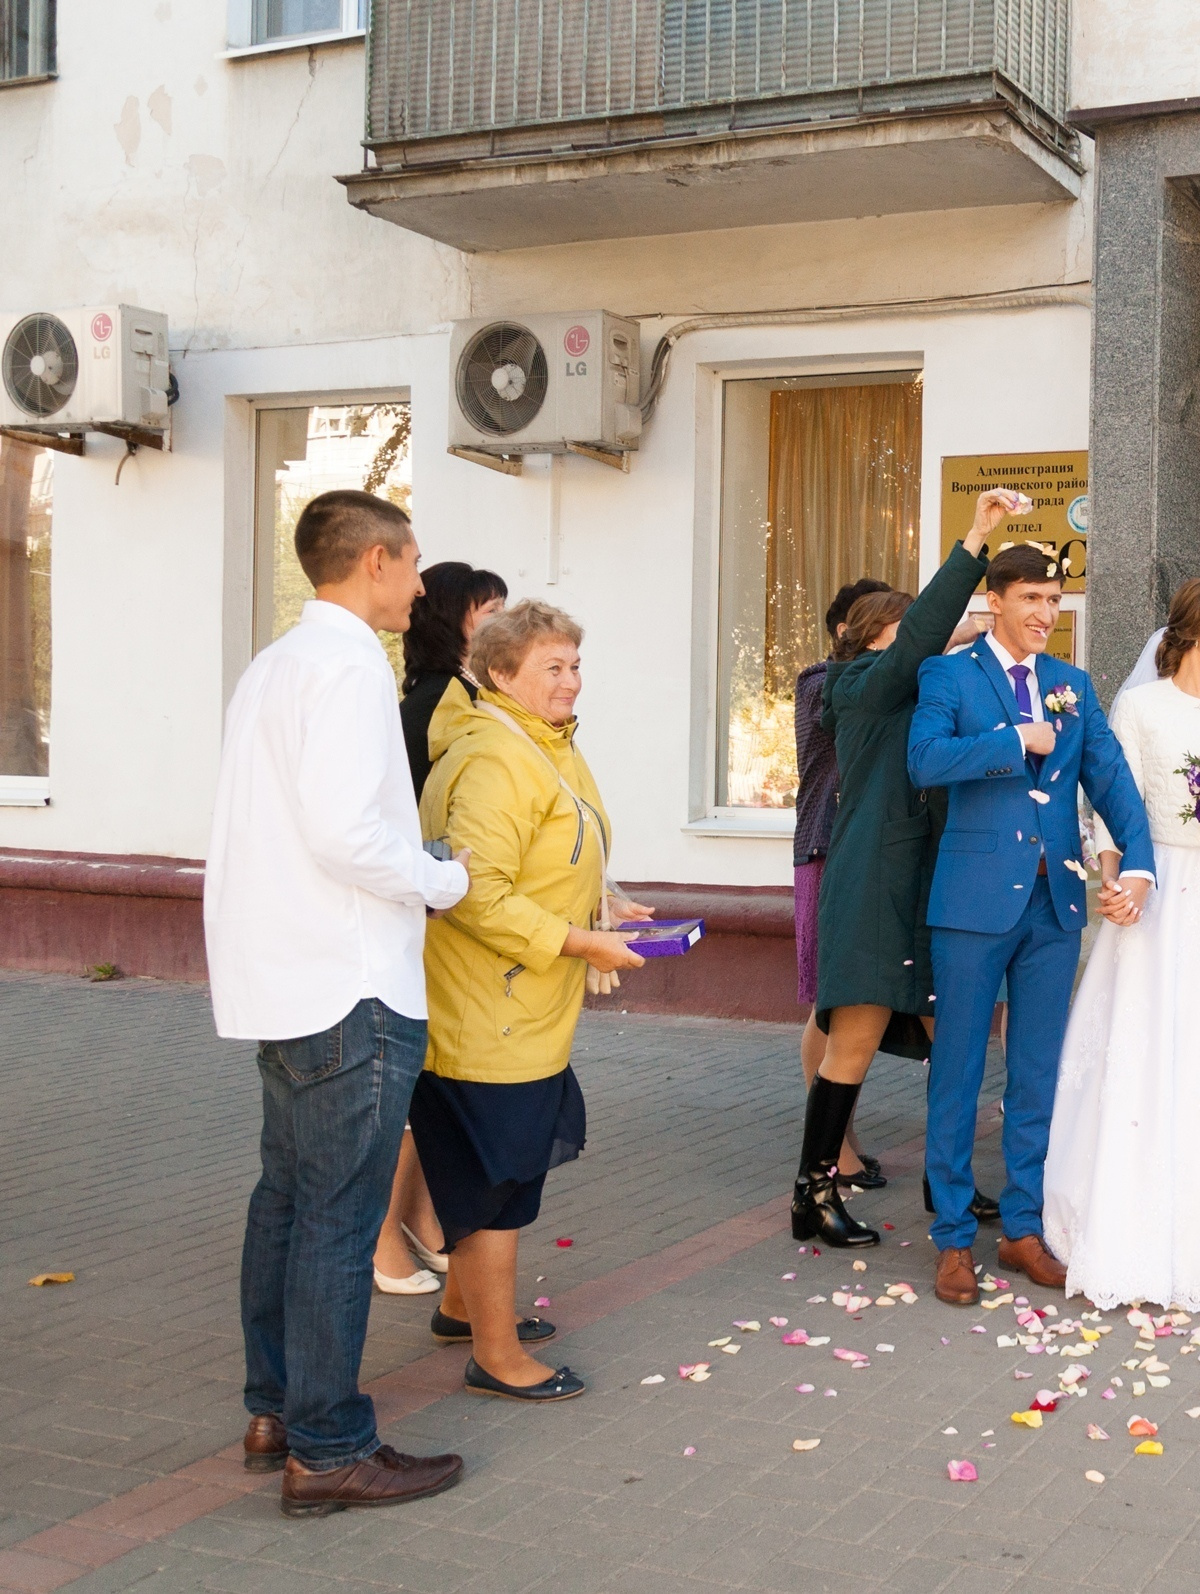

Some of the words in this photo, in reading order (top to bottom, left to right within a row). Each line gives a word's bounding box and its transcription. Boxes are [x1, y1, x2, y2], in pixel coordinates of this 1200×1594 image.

[93, 346, 111, 360] LG
[565, 361, 587, 377] LG
[976, 464, 1074, 477] Администрация
[1006, 522, 1043, 533] отдел
